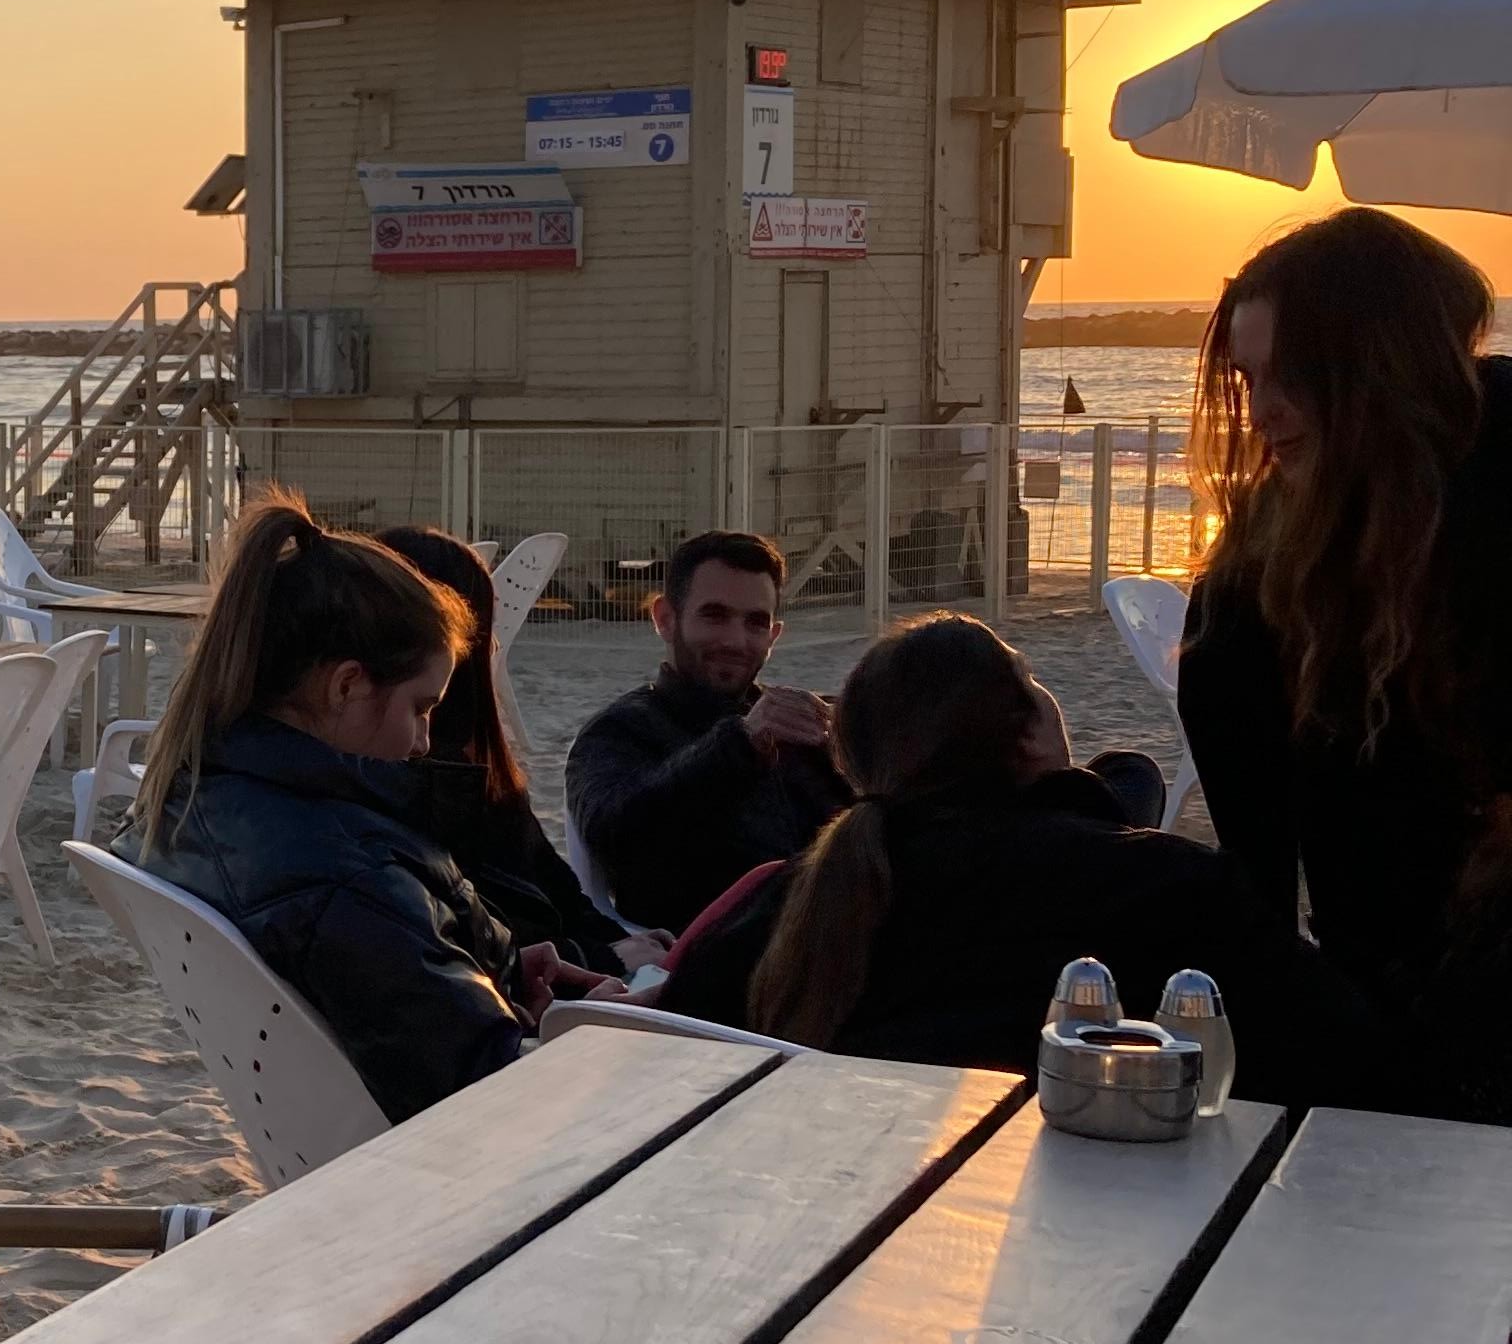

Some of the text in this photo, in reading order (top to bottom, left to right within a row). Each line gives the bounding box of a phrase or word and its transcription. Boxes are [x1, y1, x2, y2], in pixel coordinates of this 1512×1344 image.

[752, 107, 779, 128] גורדון
[539, 137, 573, 150] 07:15
[588, 135, 623, 148] 15:45
[654, 139, 667, 156] 7
[759, 142, 772, 185] 7
[411, 184, 515, 203] גורדון 7
[477, 211, 533, 225] הרחצה
[406, 231, 533, 248] אין שירותי הצלה
[830, 224, 843, 240] אין
